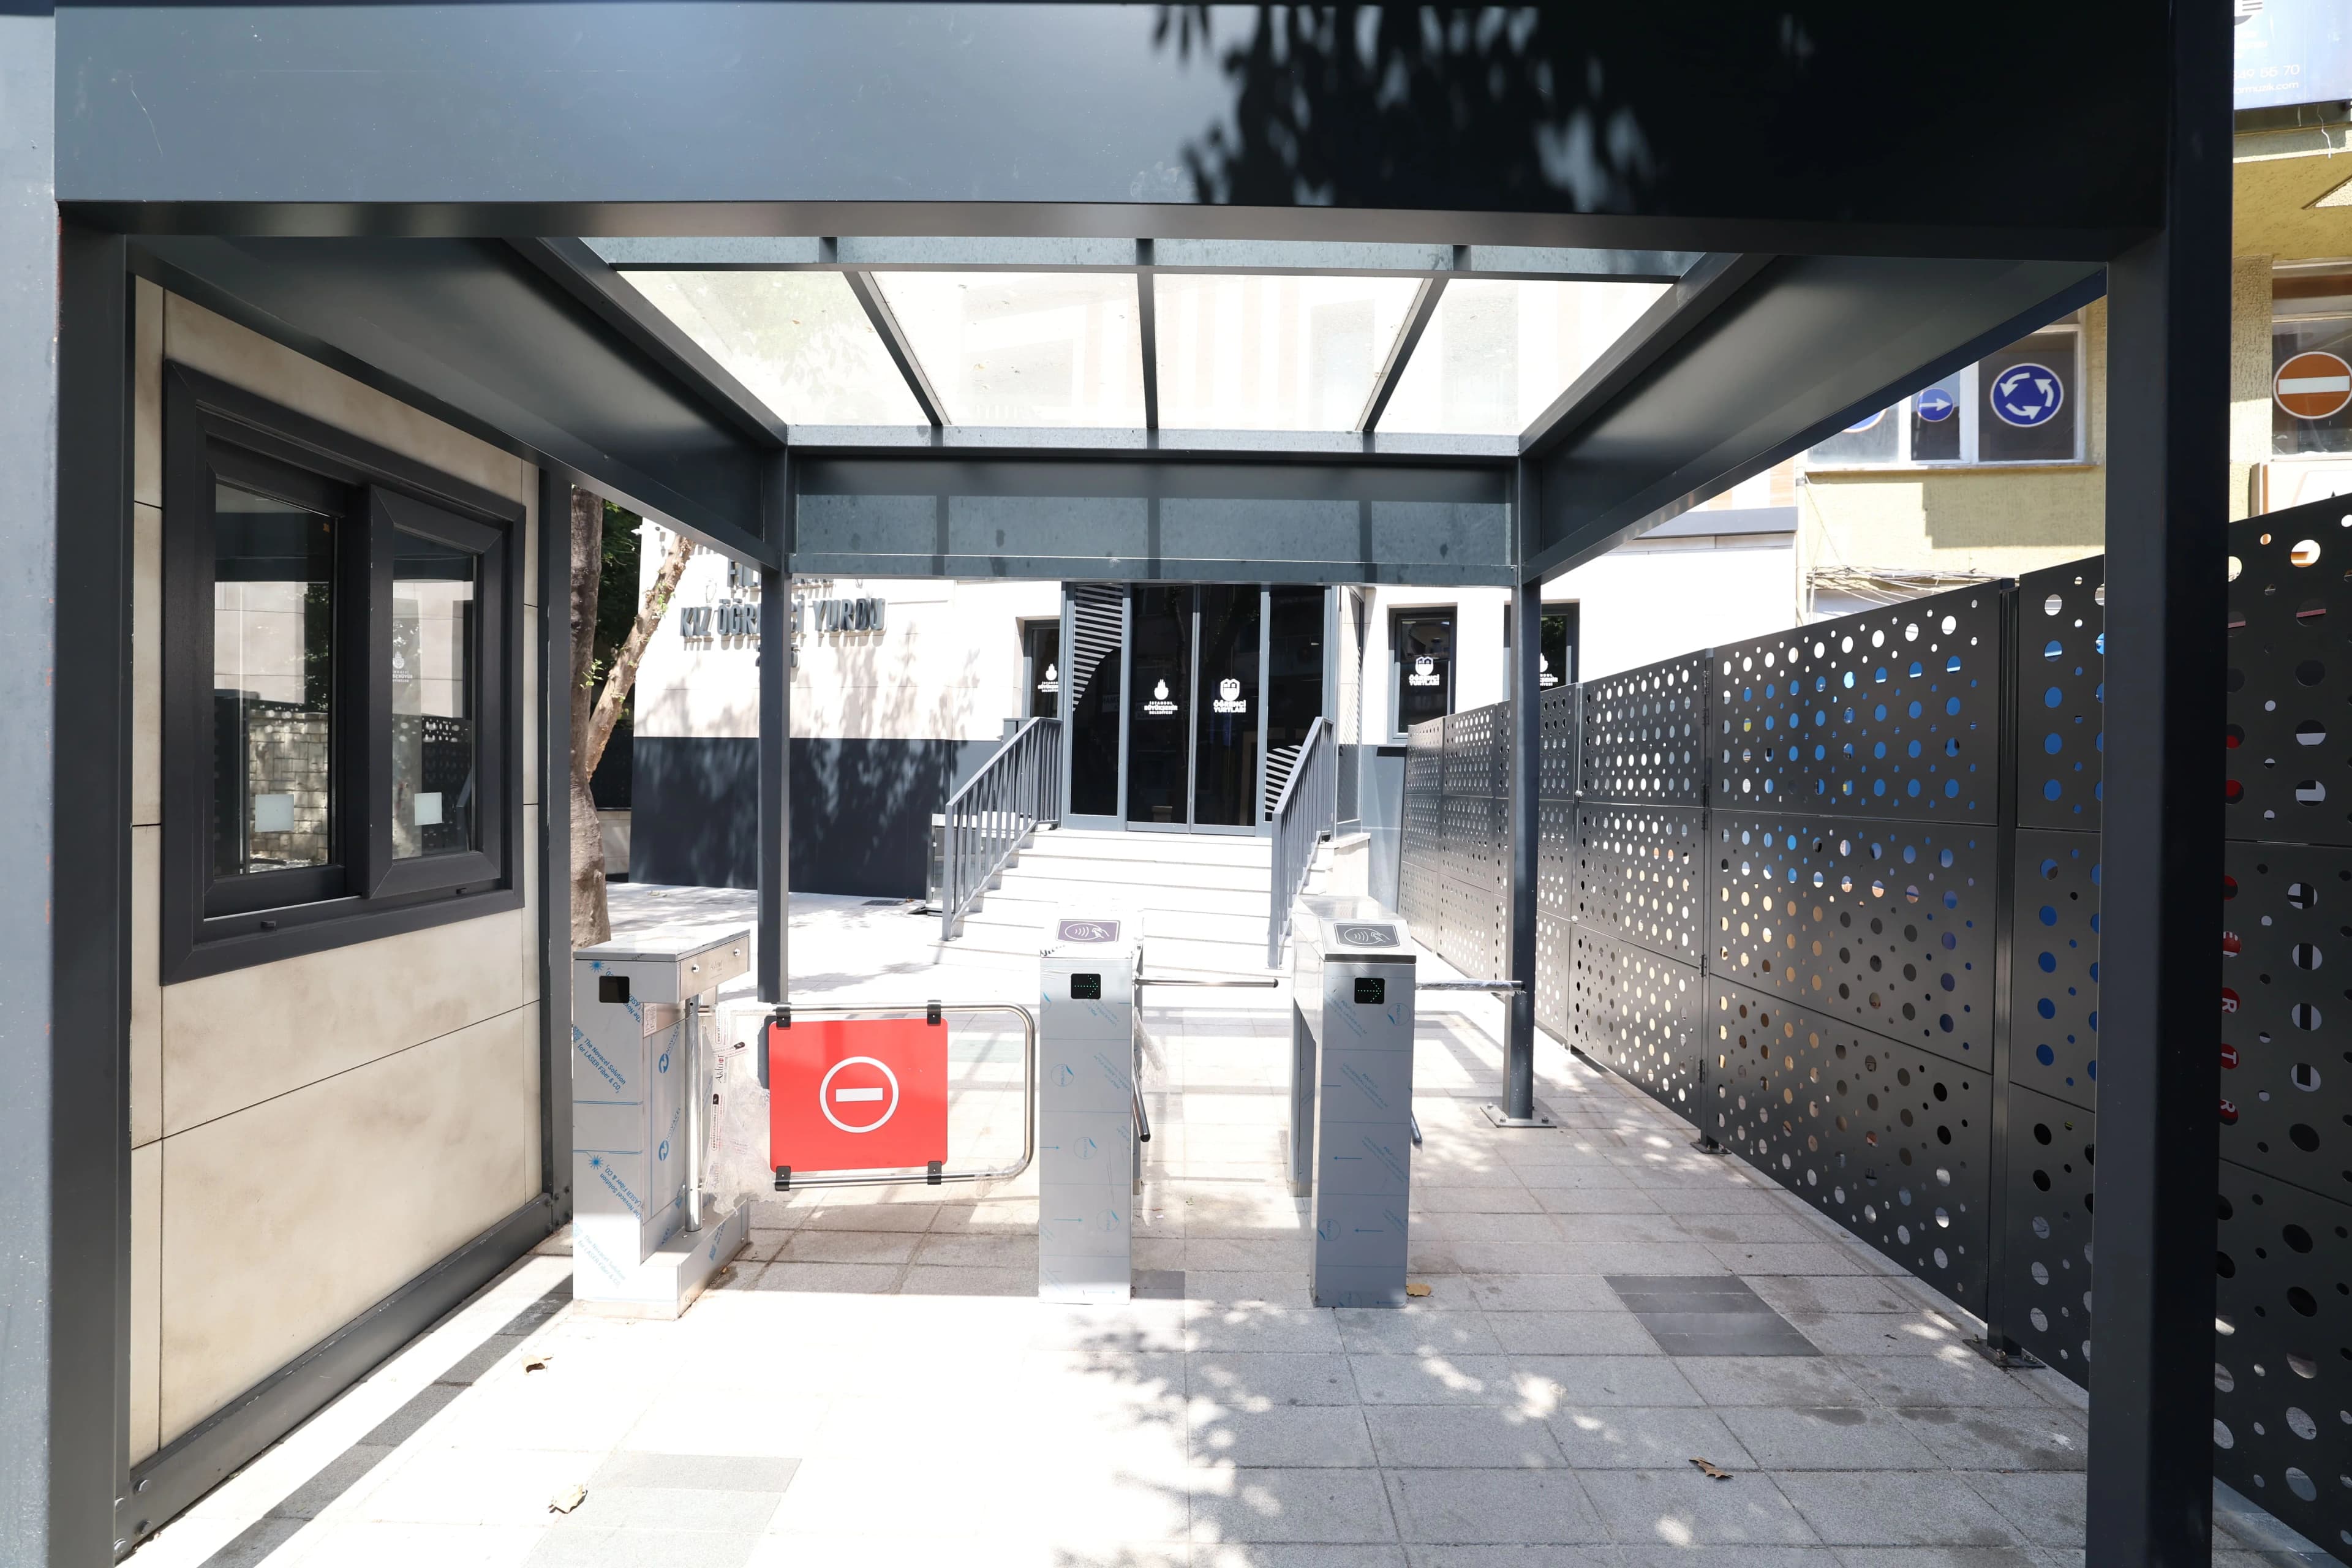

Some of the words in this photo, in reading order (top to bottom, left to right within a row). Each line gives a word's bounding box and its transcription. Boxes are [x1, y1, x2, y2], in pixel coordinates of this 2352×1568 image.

[2283, 64, 2300, 75] 70
[680, 606, 712, 636] KIZ
[813, 598, 886, 631] YURDU
[584, 1038, 593, 1049] The
[592, 1047, 610, 1066] Novacel
[608, 1065, 626, 1085] Solution
[584, 1050, 600, 1068] LASER
[598, 1066, 610, 1079] Fiber
[600, 1173, 618, 1193] Solution
